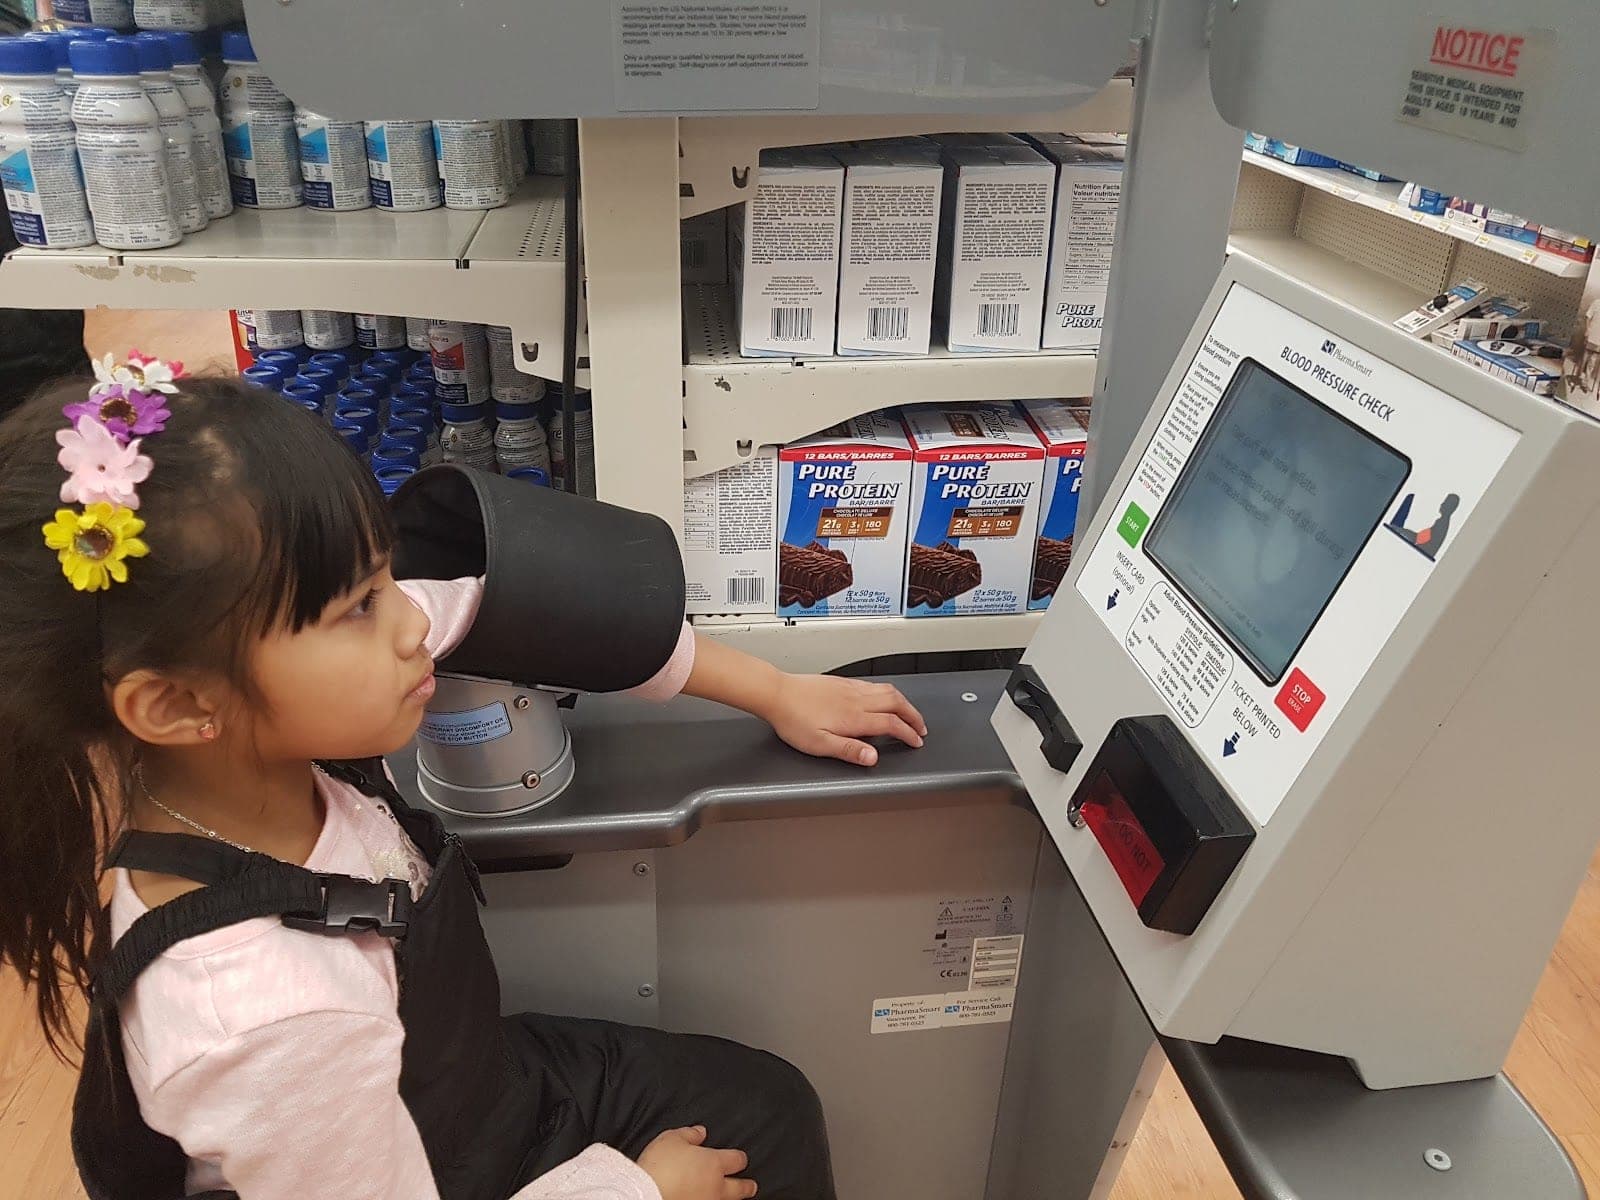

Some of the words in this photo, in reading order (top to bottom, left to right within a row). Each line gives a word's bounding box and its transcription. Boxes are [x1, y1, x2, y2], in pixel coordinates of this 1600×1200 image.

[1432, 27, 1524, 70] NOTICE
[1056, 303, 1096, 316] PURE
[1331, 347, 1375, 377] PharmaSmart
[1279, 345, 1314, 374] BLOOD
[1309, 363, 1361, 401] PRESSURE
[1355, 390, 1395, 422] CHECK
[818, 452, 894, 460] BARS/BARRES
[951, 452, 1027, 461] BARS/BARRES
[798, 464, 856, 480] PURE
[931, 464, 991, 481] PURE
[808, 482, 900, 499] PROTEIN
[941, 482, 1032, 499] PROTEIN
[980, 498, 1026, 506] BAR/BARRE
[865, 520, 882, 528] 180
[1124, 515, 1139, 533] START
[1115, 549, 1133, 571] INSERT
[1129, 565, 1146, 586] CARD
[1110, 564, 1136, 597] (optional)
[1163, 588, 1175, 604] Adult
[1172, 599, 1186, 616] Blood
[1183, 611, 1204, 635] Pressure
[1201, 631, 1226, 660] Guidelines
[1184, 626, 1203, 649] SYSTOLIC
[1205, 649, 1227, 676] DIASTOLIC
[1291, 682, 1313, 708] STOP
[1229, 678, 1255, 710] TICKET
[1250, 702, 1282, 741] PRINTED
[1231, 706, 1258, 739] BELOW
[891, 1006, 941, 1015] PharmaSmart
[962, 1002, 1012, 1011] PharmaSmart
